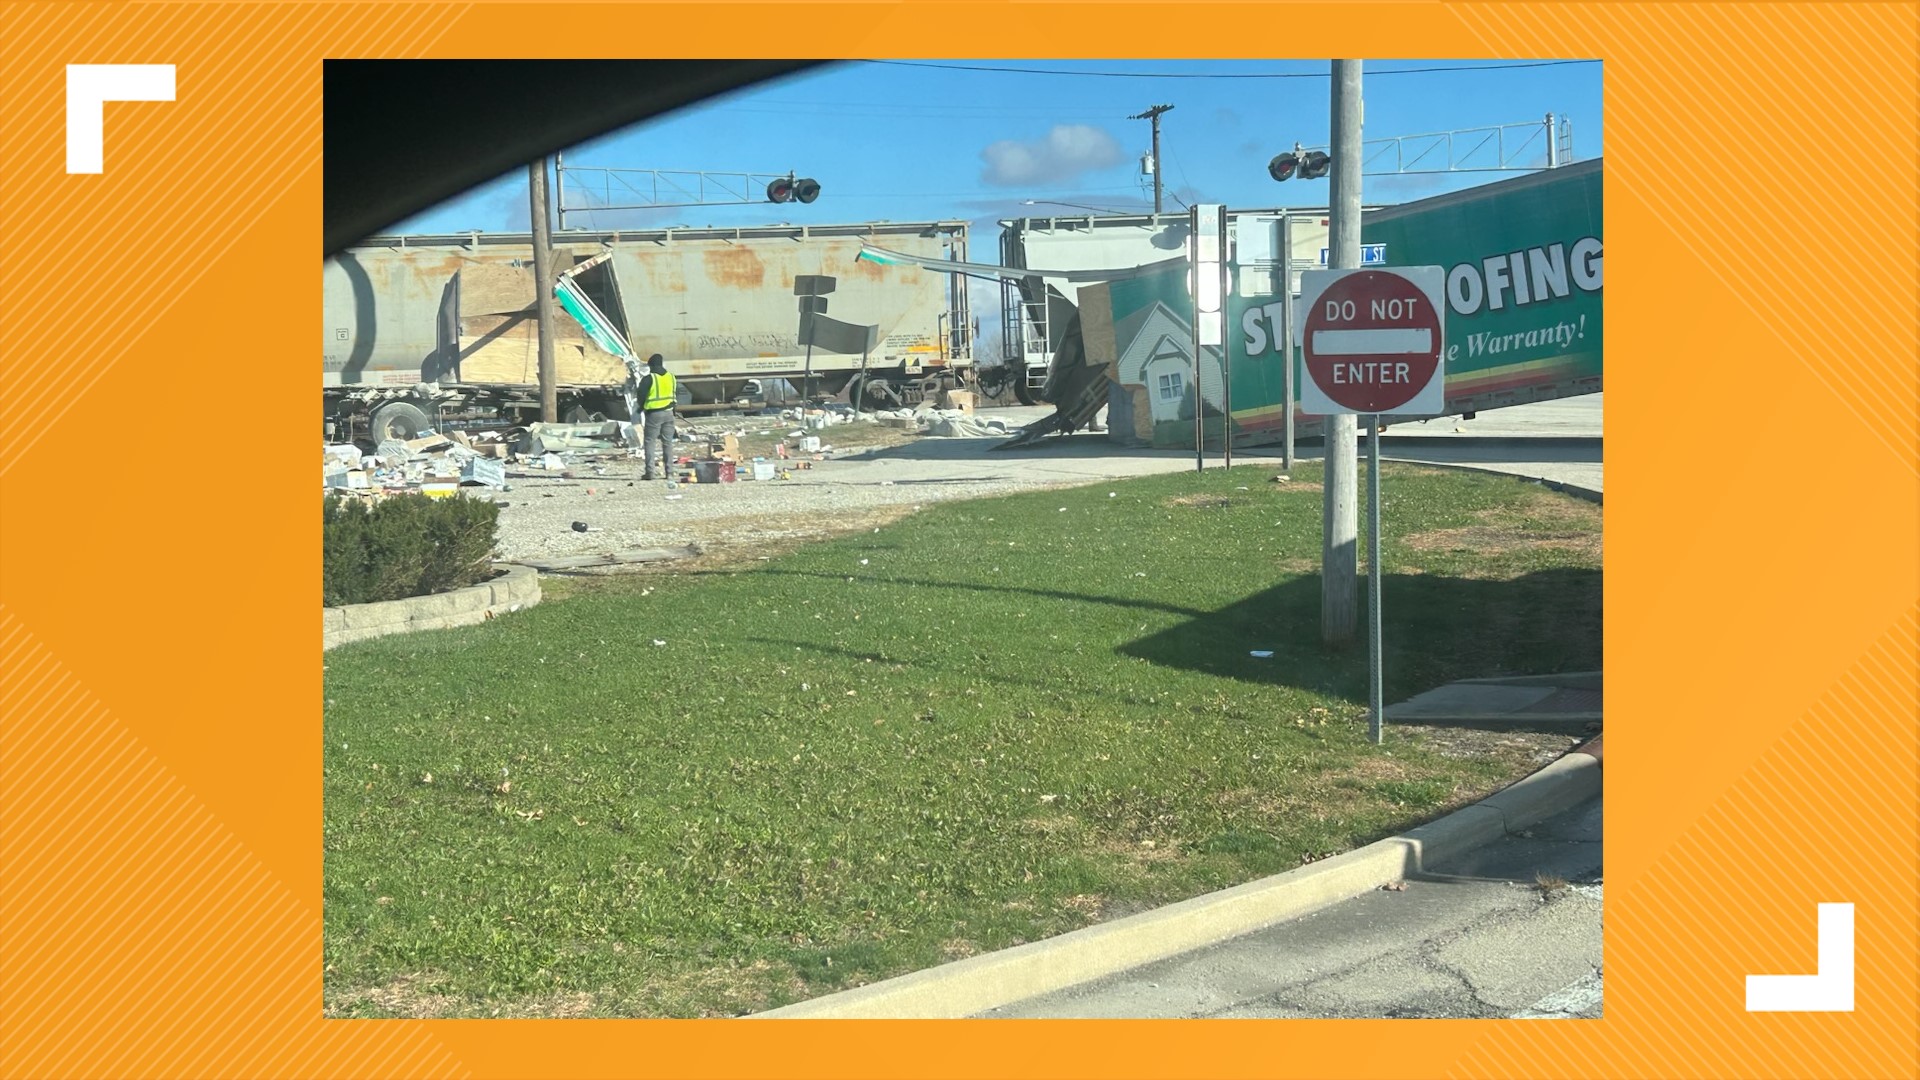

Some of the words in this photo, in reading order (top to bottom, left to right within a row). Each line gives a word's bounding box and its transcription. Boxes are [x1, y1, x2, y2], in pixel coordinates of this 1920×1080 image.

[1373, 247, 1385, 262] ST
[1447, 236, 1603, 315] OFING
[1326, 300, 1356, 321] DO
[1371, 298, 1418, 320] NOT
[1467, 314, 1586, 358] Warranty!
[1333, 362, 1410, 384] ENTER
